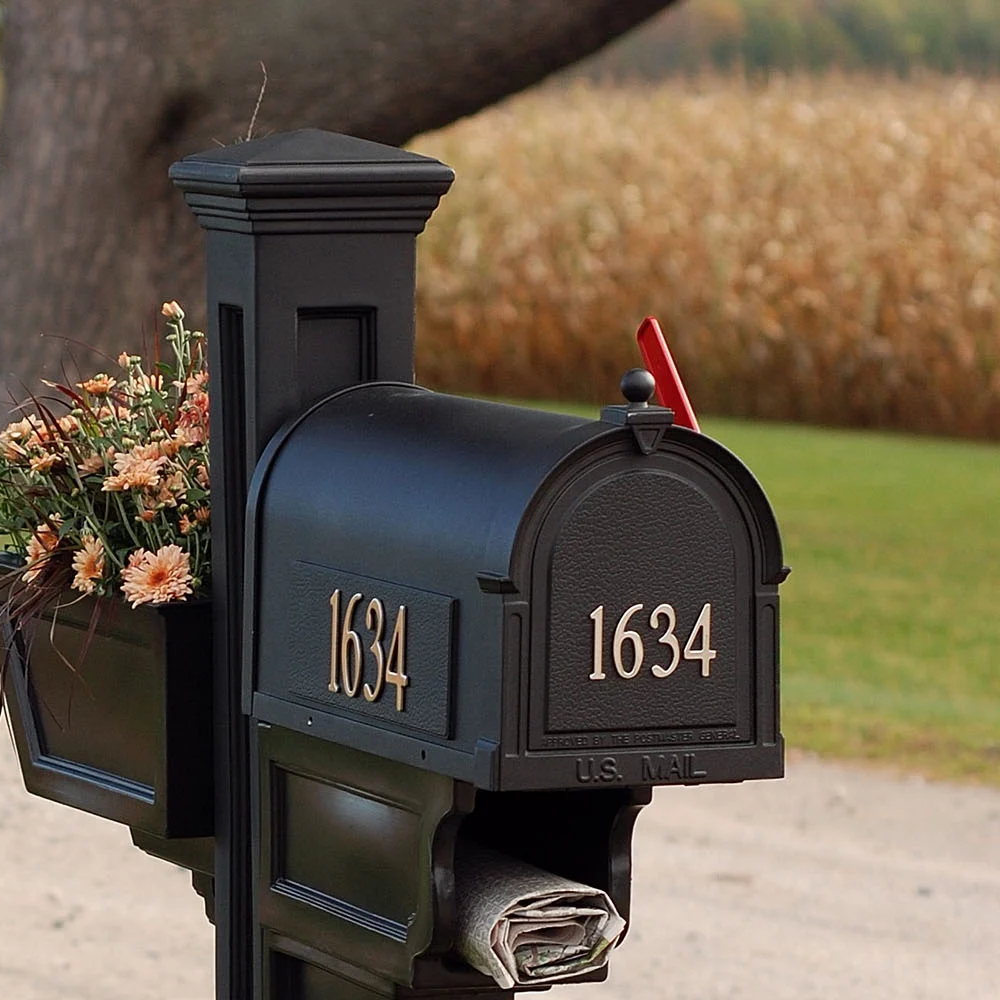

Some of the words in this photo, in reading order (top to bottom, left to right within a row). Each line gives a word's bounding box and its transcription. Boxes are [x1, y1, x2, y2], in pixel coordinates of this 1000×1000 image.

[327, 588, 410, 712] 1634
[588, 602, 718, 680] 1634
[542, 736, 588, 747] APPROVED
[592, 735, 606, 745] BY
[611, 734, 630, 744] THE
[633, 731, 693, 744] POSTMASTER
[699, 728, 741, 741] GENERAL
[575, 756, 623, 784] U.S.
[641, 752, 708, 781] MAIL
